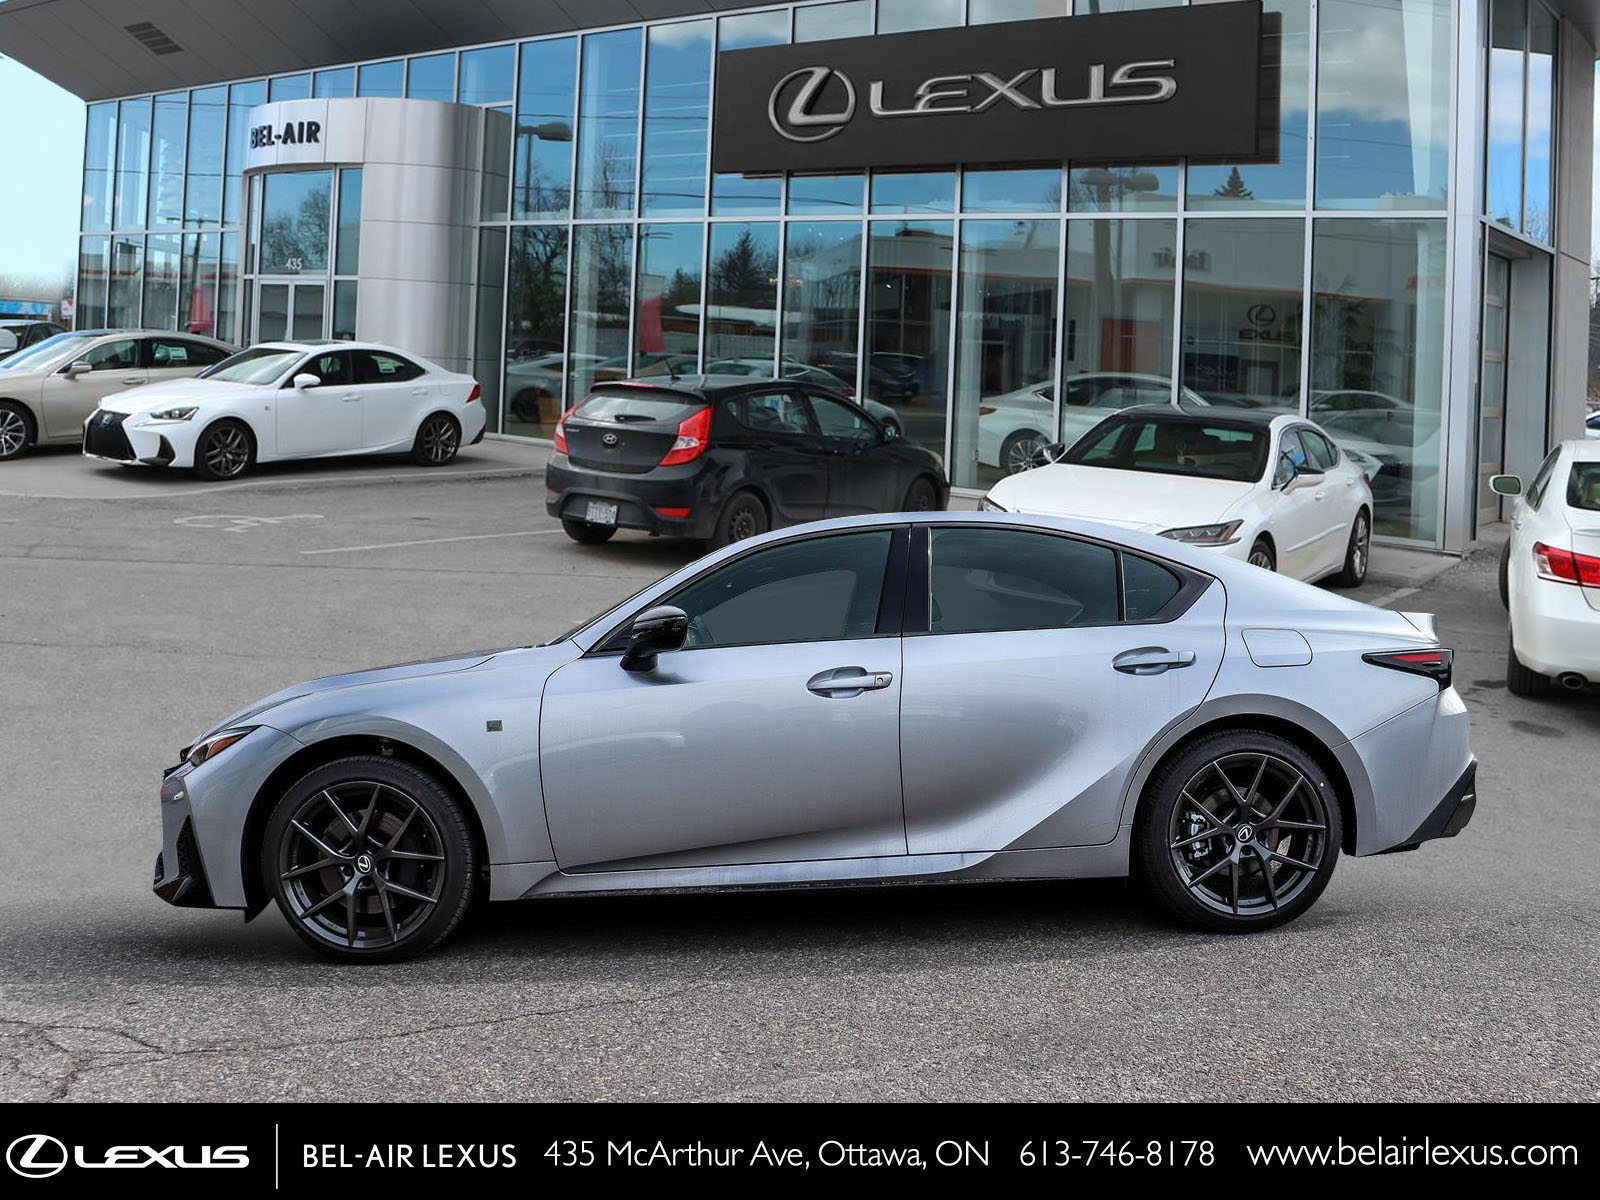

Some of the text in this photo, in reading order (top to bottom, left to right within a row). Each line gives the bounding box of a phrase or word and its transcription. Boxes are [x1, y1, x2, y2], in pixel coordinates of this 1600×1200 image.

[869, 59, 1178, 118] LEXUS
[250, 121, 321, 149] BEL-AIR
[286, 257, 303, 270] 435
